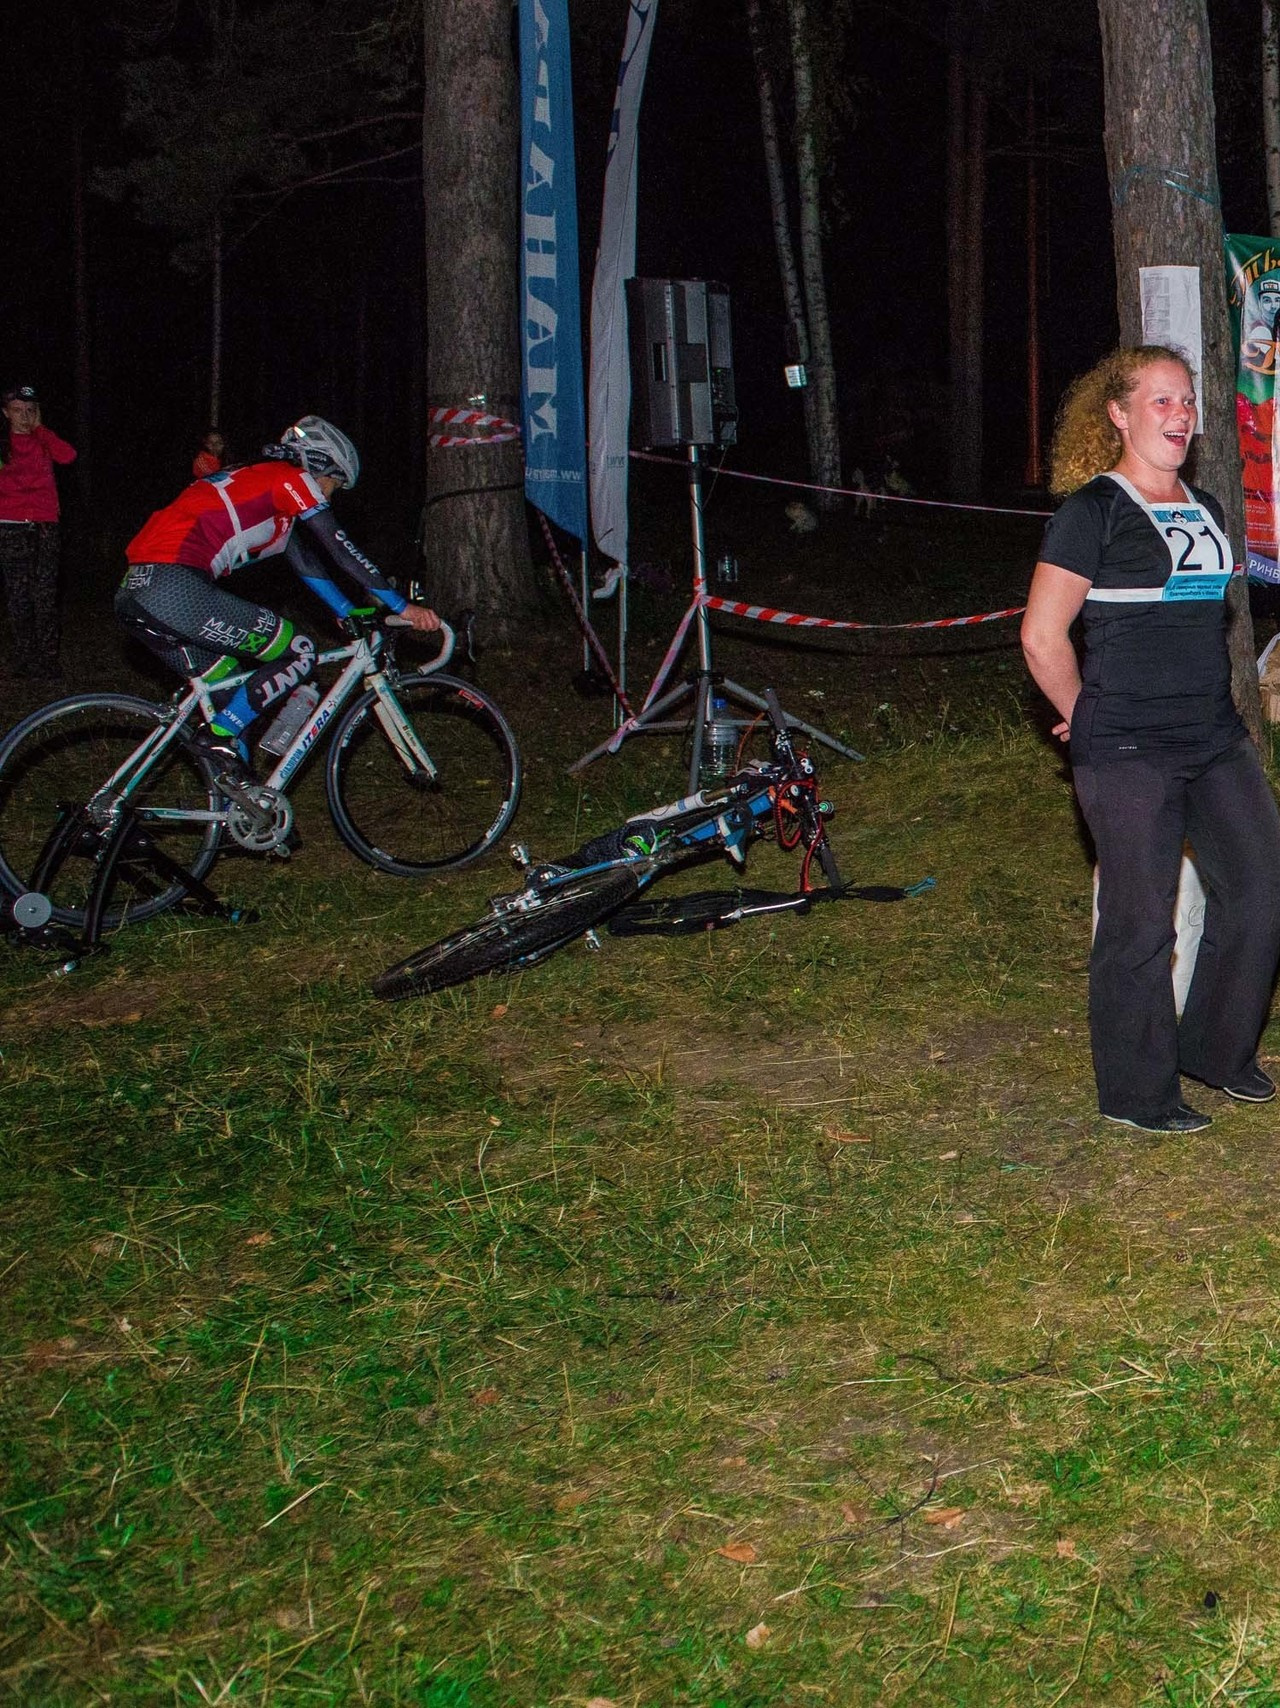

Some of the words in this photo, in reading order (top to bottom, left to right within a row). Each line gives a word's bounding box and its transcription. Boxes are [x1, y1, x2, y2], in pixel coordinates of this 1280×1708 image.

[343, 540, 380, 574] GIANT
[1164, 525, 1225, 571] 21
[198, 626, 241, 650] TEAM
[205, 617, 248, 640] MULTI
[303, 709, 330, 749] ITERA
